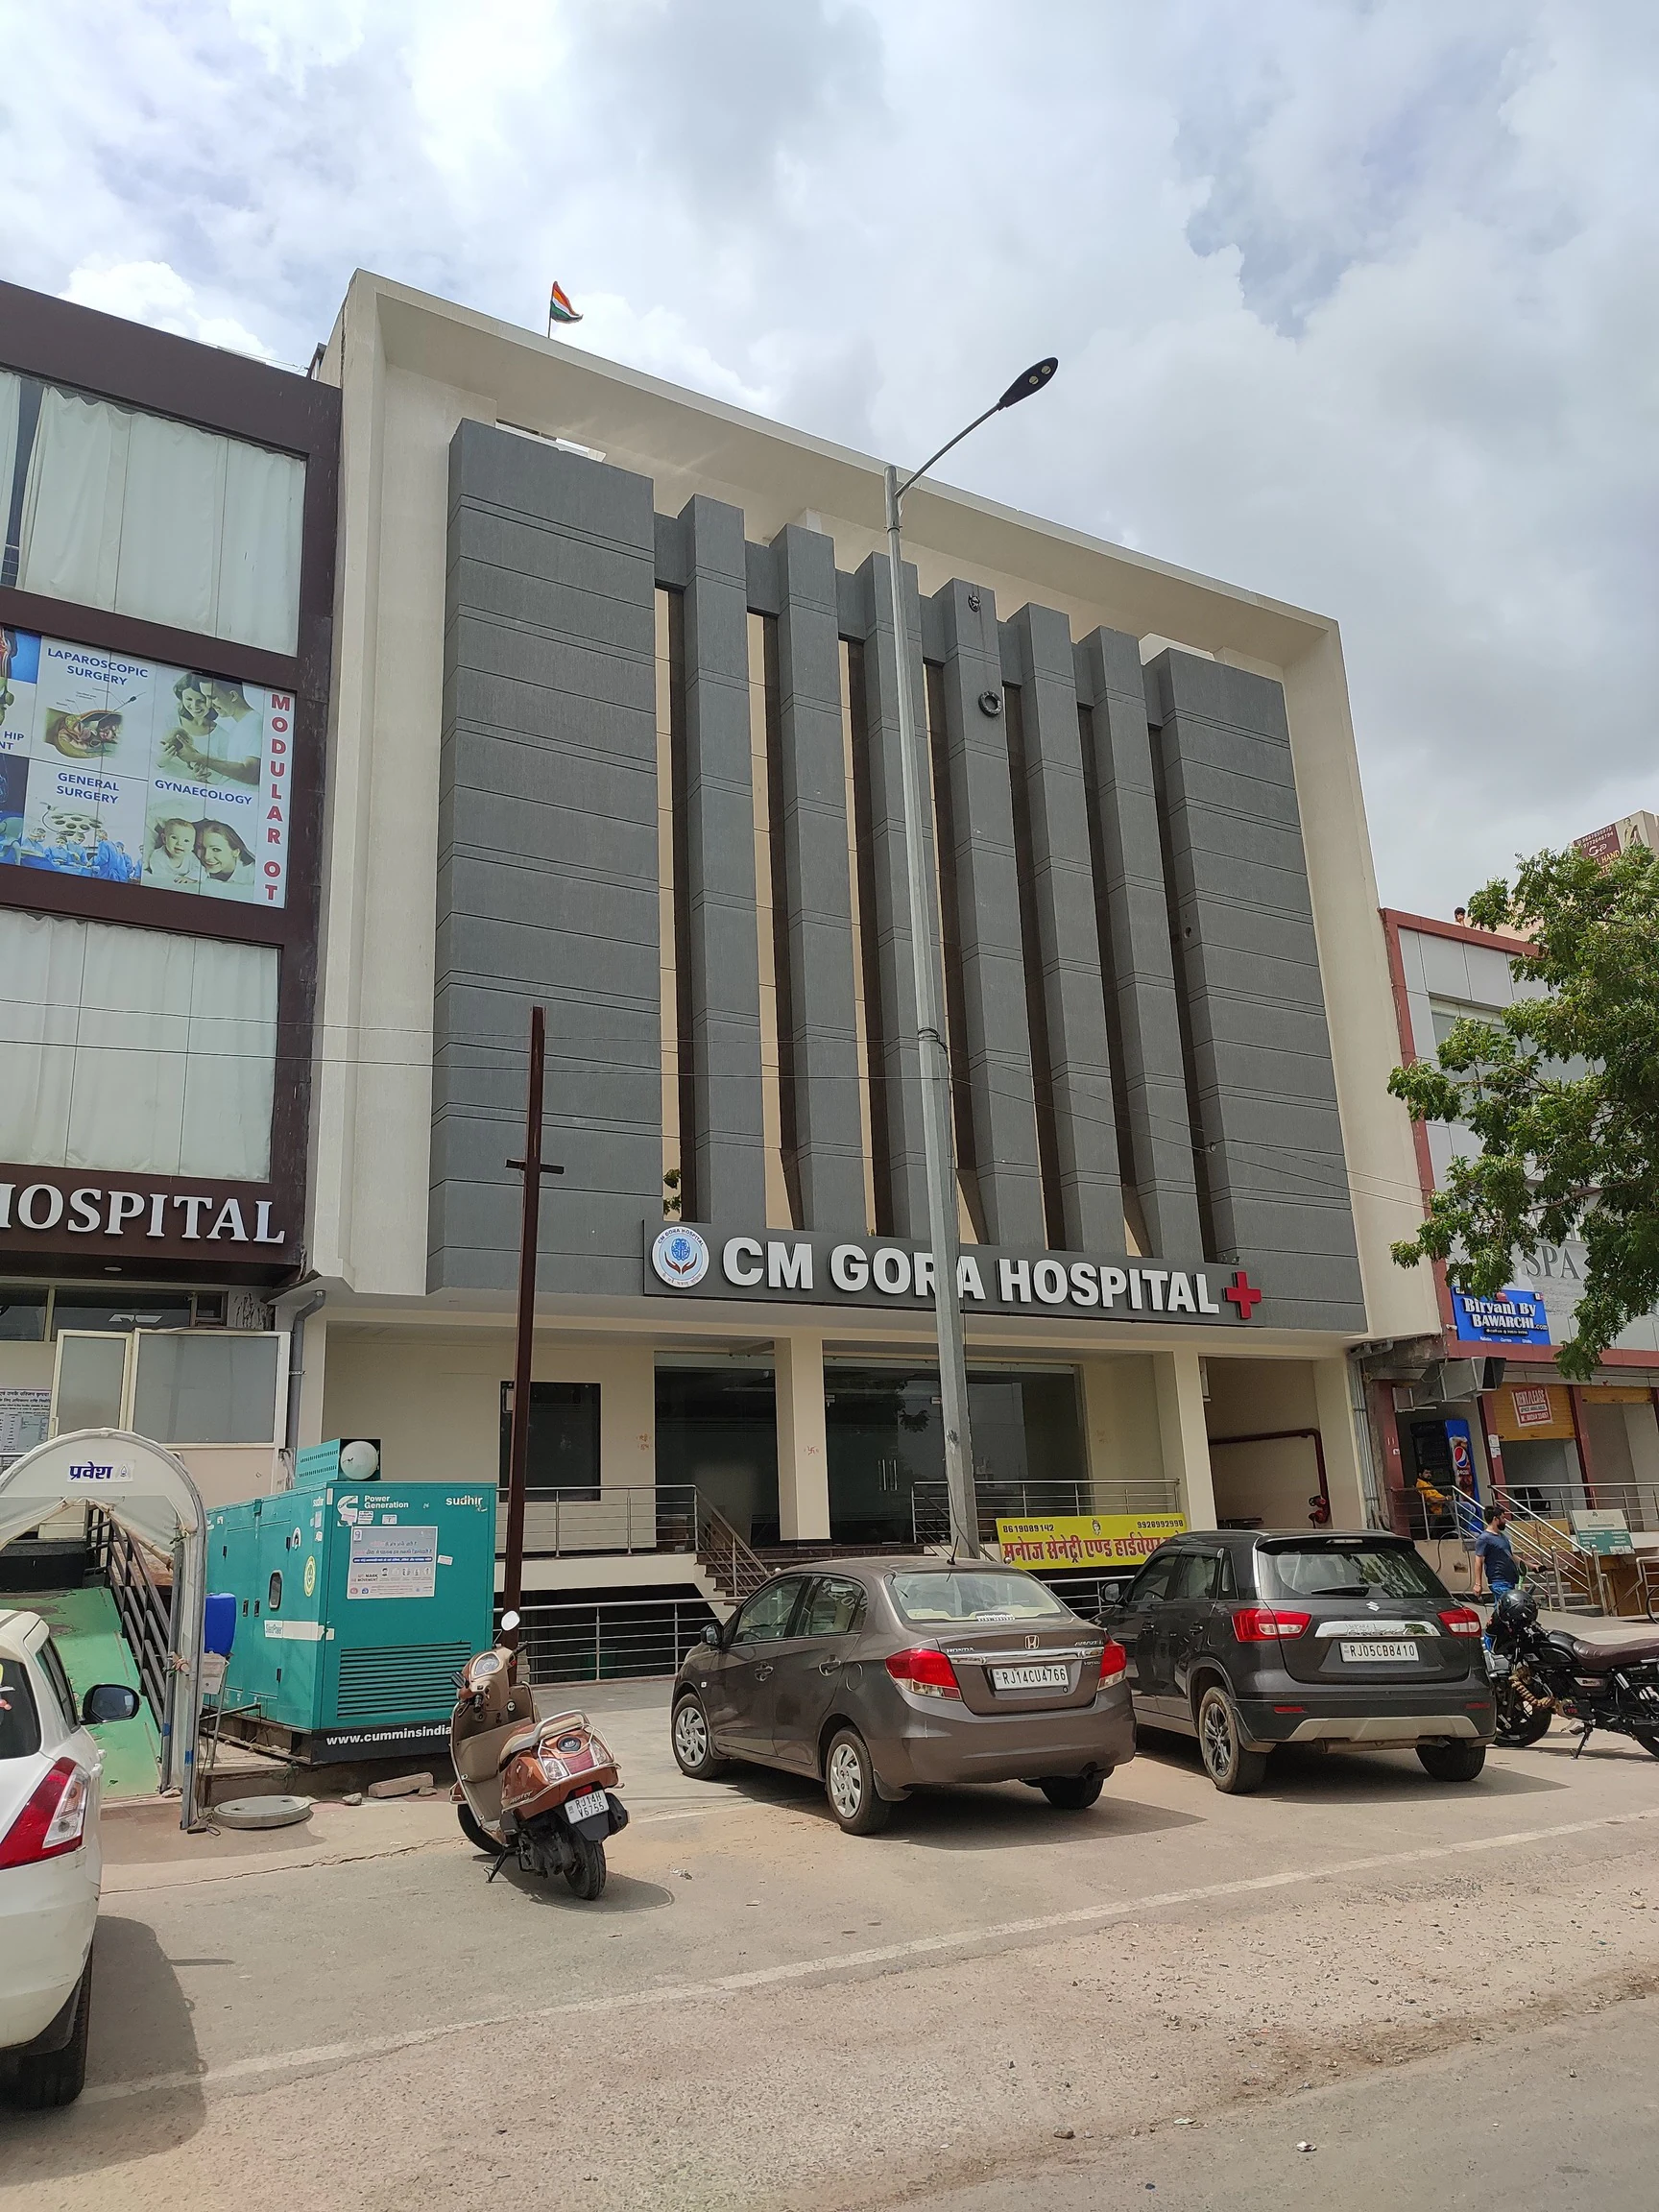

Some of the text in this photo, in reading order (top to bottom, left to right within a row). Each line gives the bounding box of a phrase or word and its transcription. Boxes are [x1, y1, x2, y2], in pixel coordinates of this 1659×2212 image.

[47, 648, 148, 678] LAPAROSCOPIC
[66, 665, 128, 685] SURGERY
[4, 731, 25, 740] HIP
[58, 772, 120, 791] GENERAL
[56, 785, 119, 805] SURGERY
[155, 780, 252, 805] GYNAECOLOGY
[263, 694, 290, 901] MODULAR OT
[723, 1237, 1220, 1314] CM GORA HOSPITAL
[1463, 1297, 1536, 1317] Biryani By
[69, 1461, 113, 1480] प्रवेश
[445, 1495, 484, 1506] sudhir
[1002, 1536, 1045, 1561] मनोज
[1349, 1644, 1415, 1657] RJ05CB8410
[1002, 1668, 1067, 1685] RJ14CU4766
